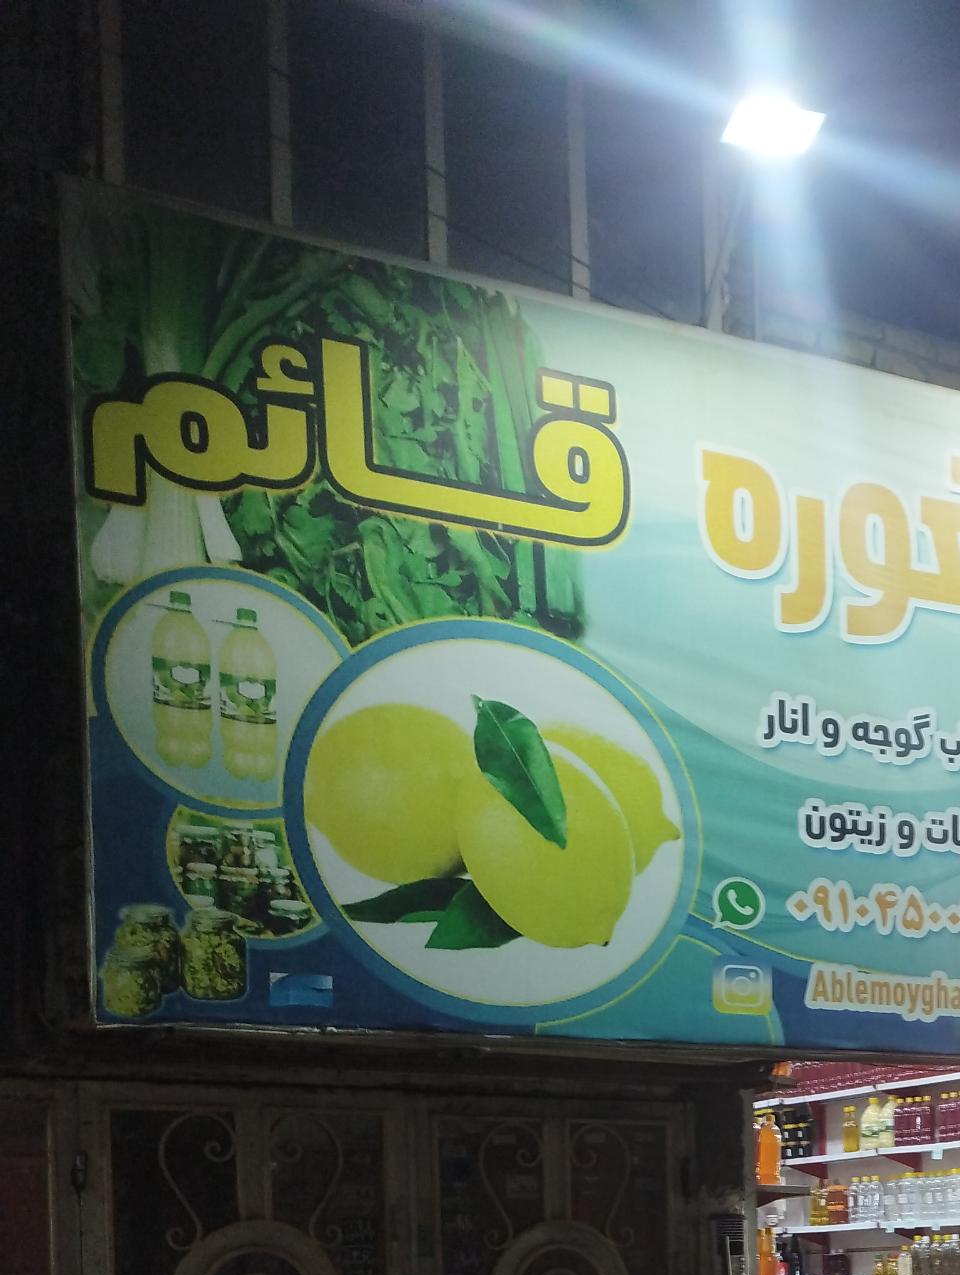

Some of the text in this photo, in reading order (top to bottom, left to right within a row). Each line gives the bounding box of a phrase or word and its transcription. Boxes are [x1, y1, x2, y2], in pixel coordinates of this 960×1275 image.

[88, 337, 630, 545] قائم
[763, 699, 809, 741] انار
[821, 717, 840, 748] و
[851, 713, 930, 758] گوجه
[805, 805, 887, 846] زیتون
[898, 819, 914, 850] و
